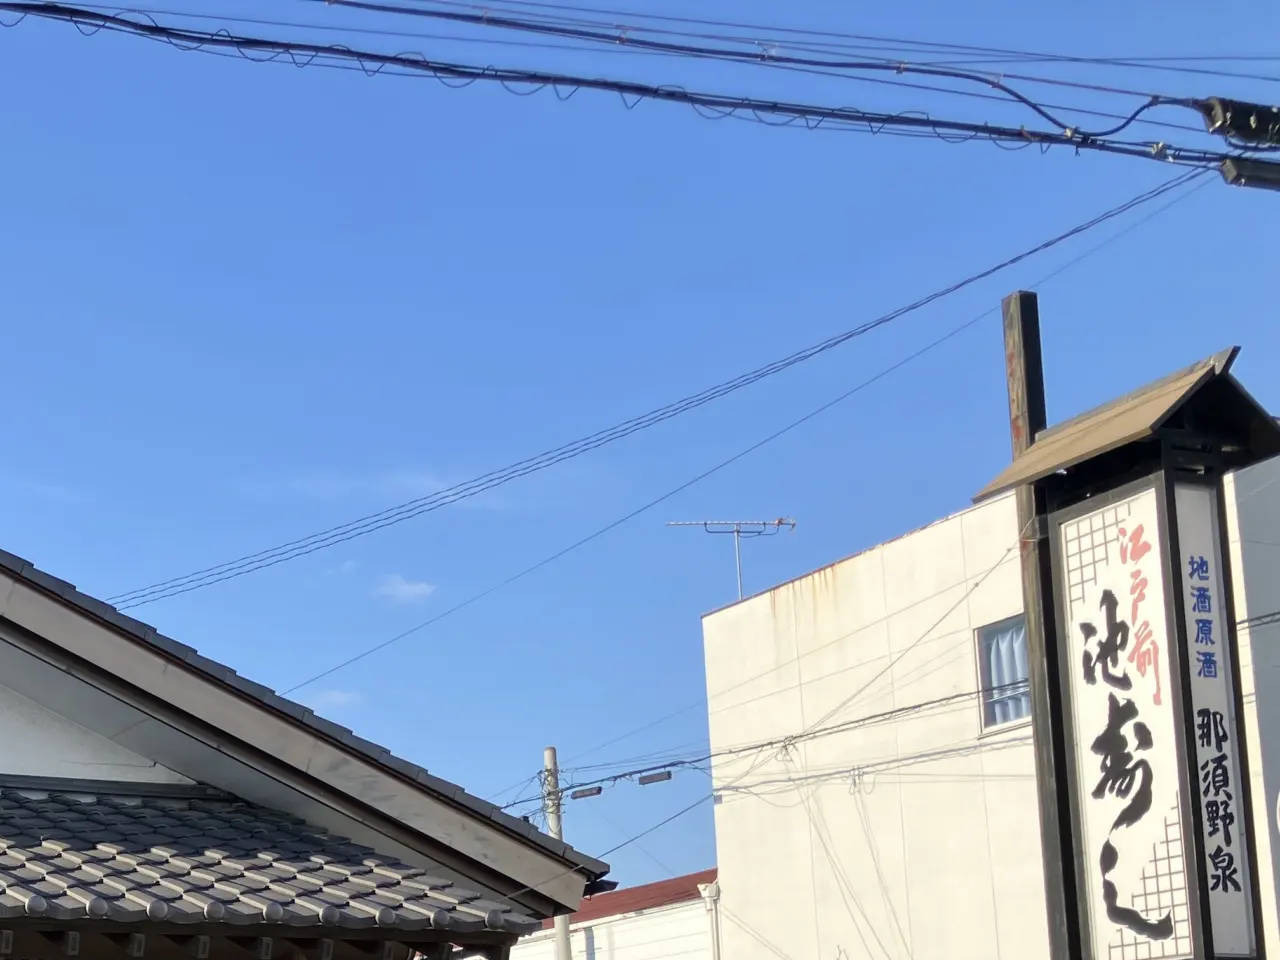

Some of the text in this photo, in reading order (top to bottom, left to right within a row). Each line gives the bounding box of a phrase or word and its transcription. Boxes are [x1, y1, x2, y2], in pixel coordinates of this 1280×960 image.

[1119, 524, 1162, 705] 江戸前
[1188, 556, 1242, 892] 地酒原酒 那須野泉
